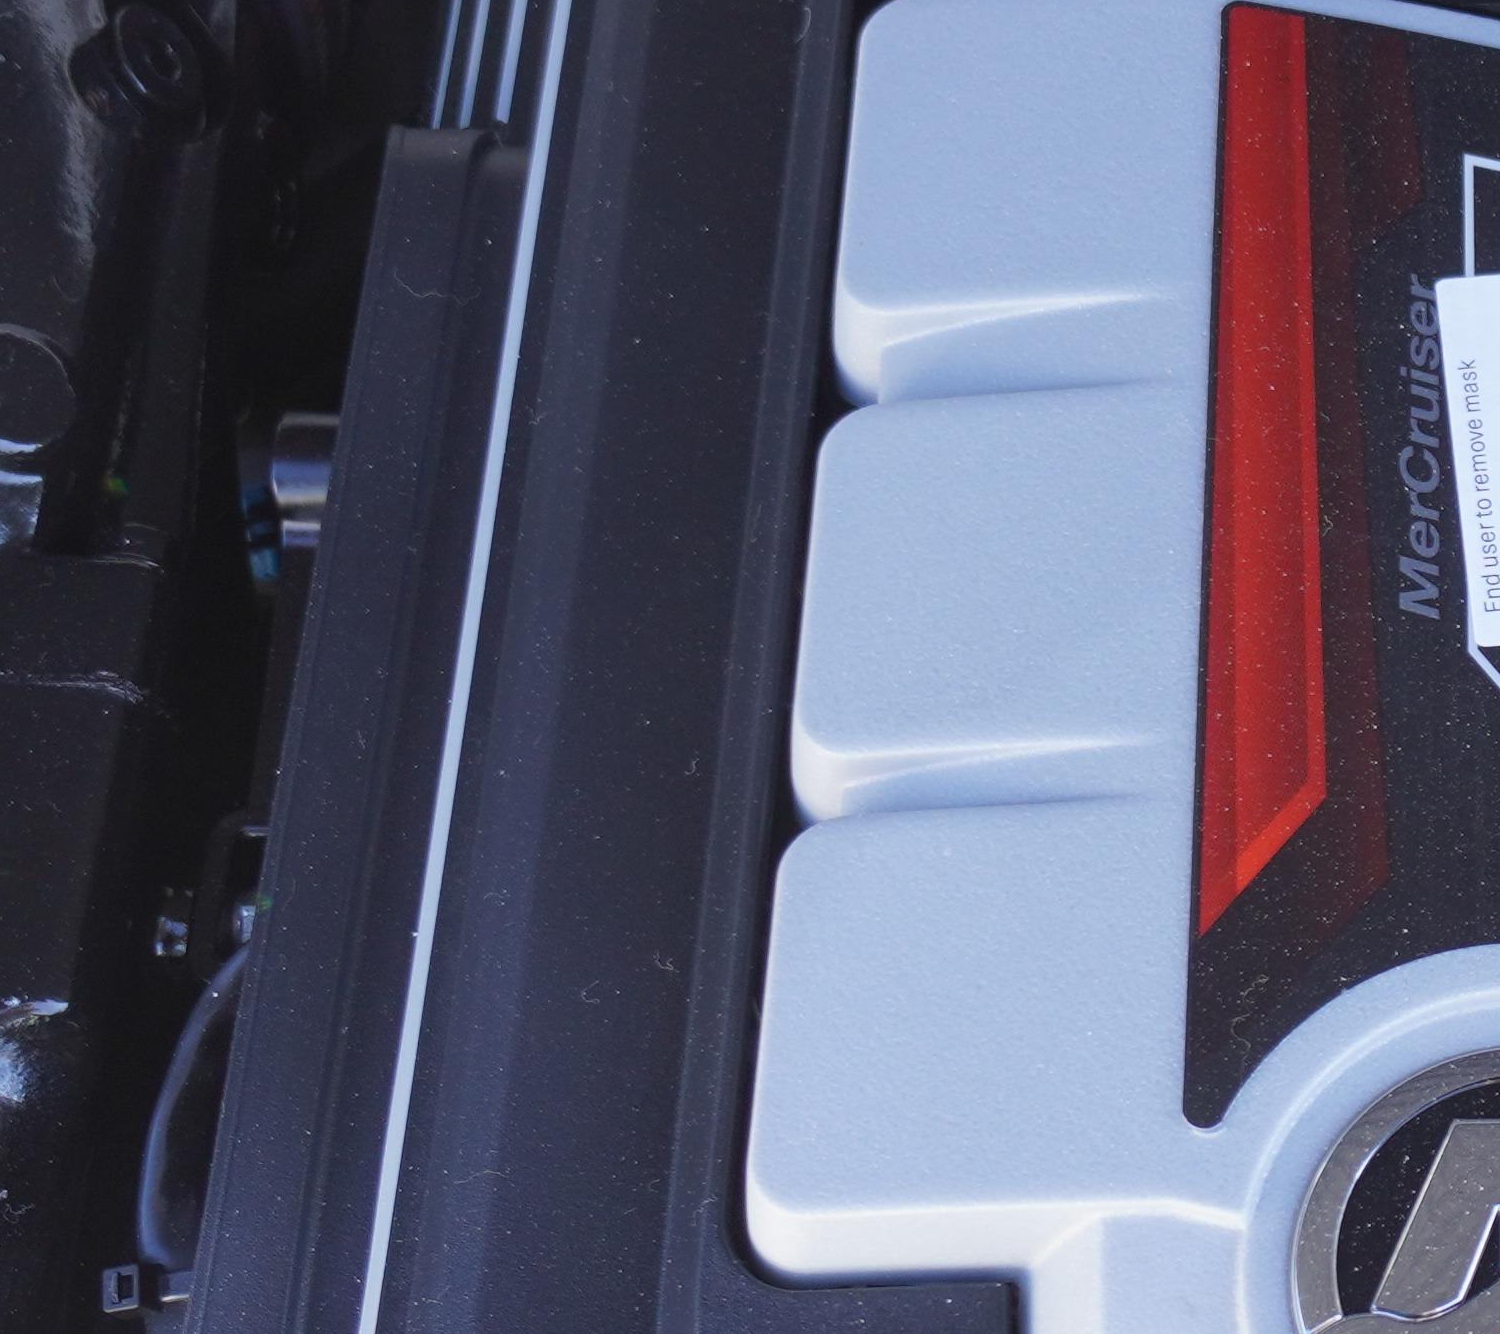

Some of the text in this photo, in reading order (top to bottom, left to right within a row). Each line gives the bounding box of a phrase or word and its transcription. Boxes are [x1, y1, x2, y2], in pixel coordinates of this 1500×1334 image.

[1457, 359, 1483, 412] mask
[1398, 274, 1441, 620] MerCruiser
[1465, 418, 1491, 492] remove
[1474, 498, 1493, 517] to
[1476, 522, 1500, 567] user
